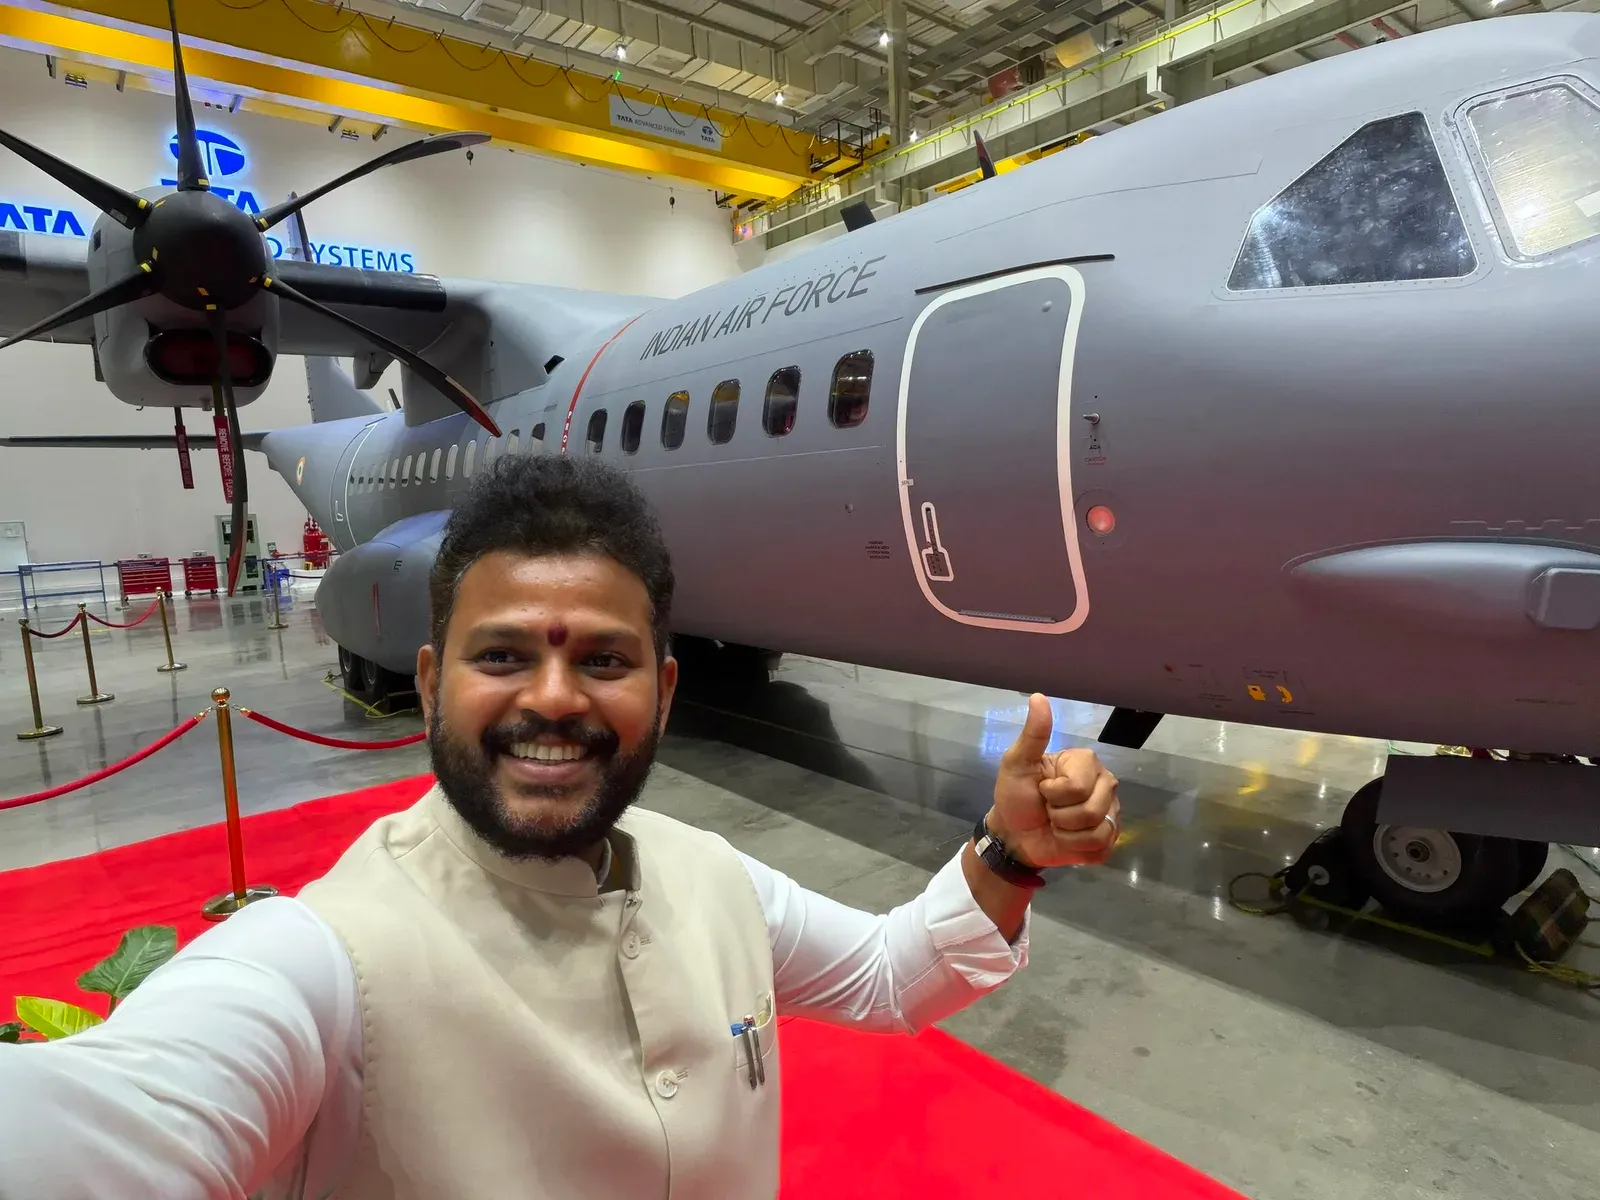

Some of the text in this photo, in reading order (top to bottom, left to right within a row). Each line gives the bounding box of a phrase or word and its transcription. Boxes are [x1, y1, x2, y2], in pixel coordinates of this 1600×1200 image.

[617, 114, 633, 124] TATA
[663, 126, 686, 137] SYSTEMS
[701, 135, 715, 144] TATA
[639, 255, 887, 361] INDIAN AIR FORCE
